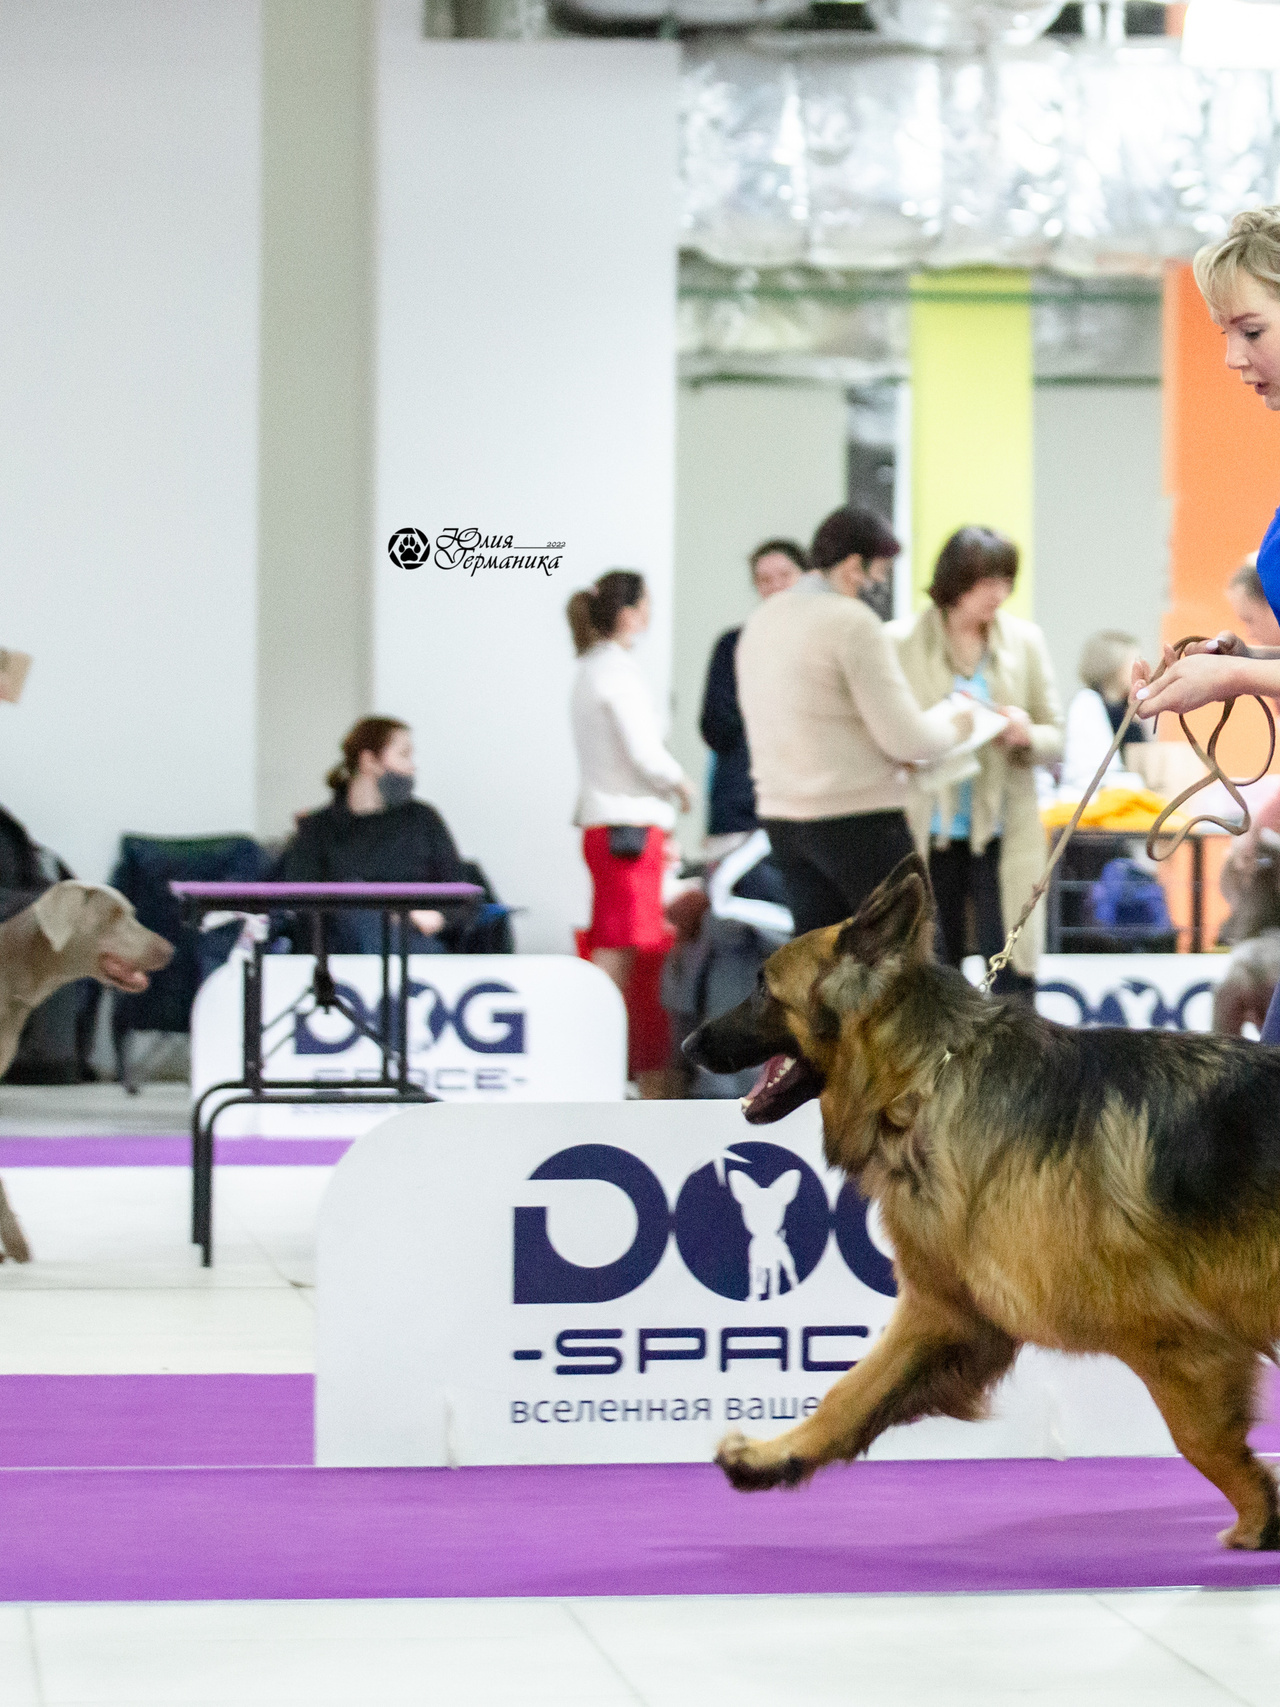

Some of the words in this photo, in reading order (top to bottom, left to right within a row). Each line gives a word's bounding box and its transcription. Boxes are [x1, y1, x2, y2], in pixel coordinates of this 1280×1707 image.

[294, 979, 527, 1054] DOG
[512, 1325, 888, 1375] -SPAC
[510, 1398, 712, 1424] вселенная
